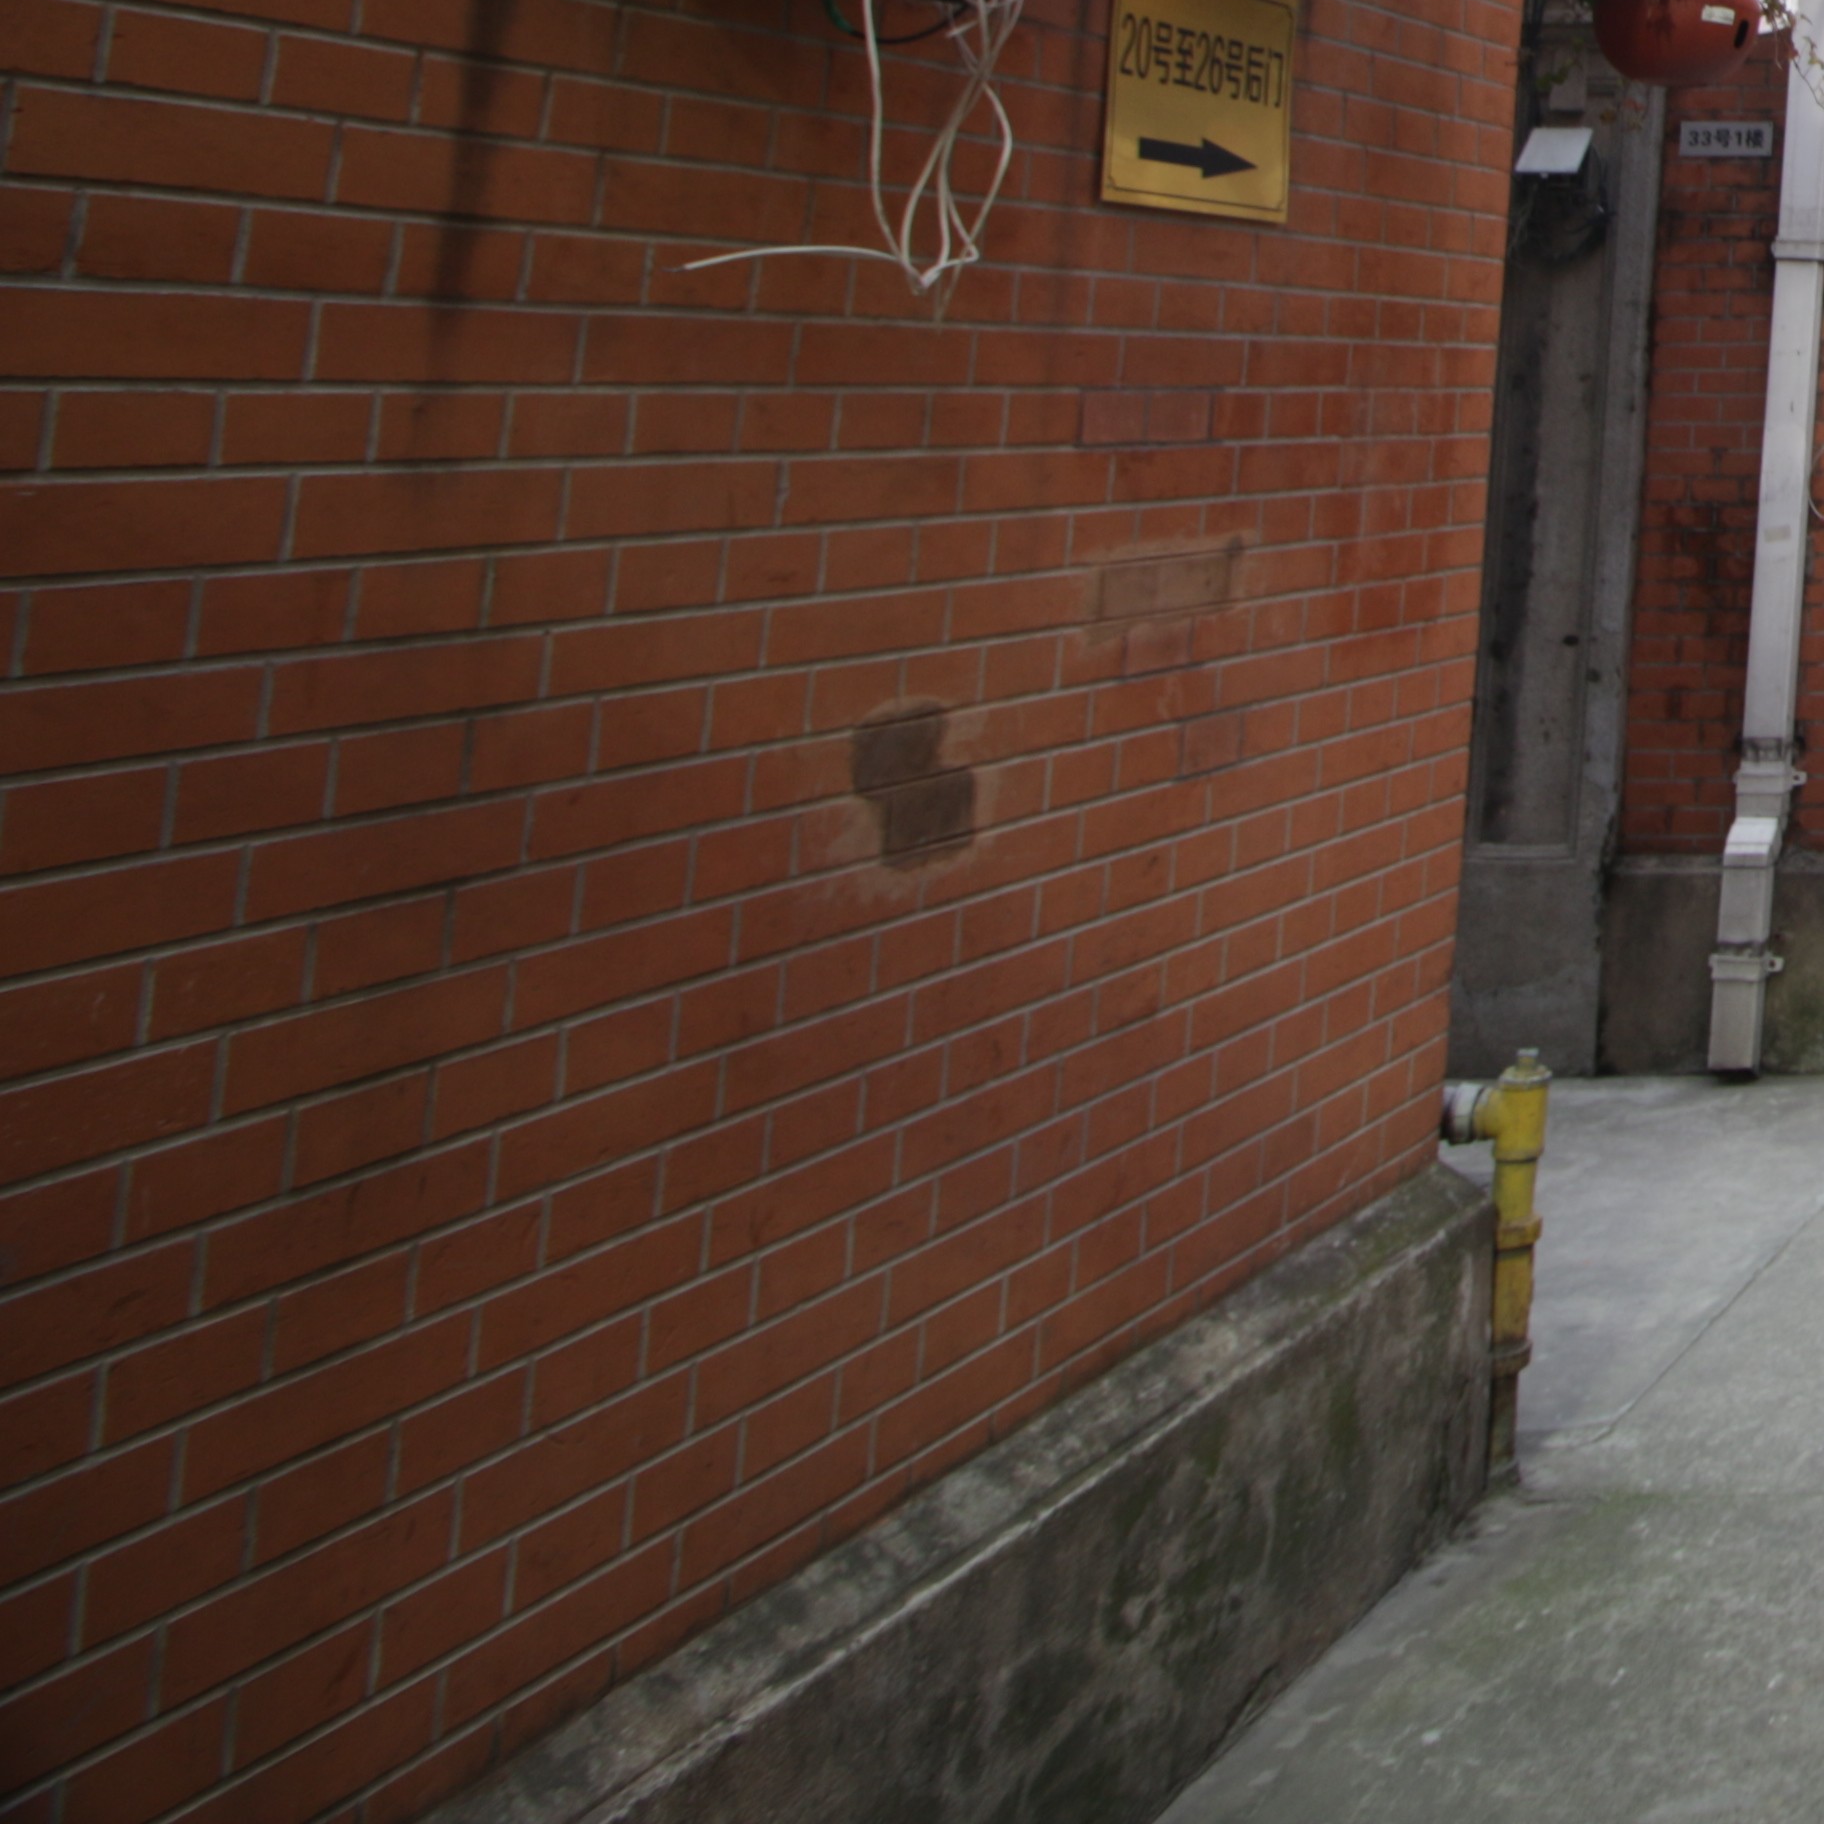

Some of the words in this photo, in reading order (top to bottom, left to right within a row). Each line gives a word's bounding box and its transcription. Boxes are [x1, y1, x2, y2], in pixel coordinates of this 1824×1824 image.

[1119, 13, 1284, 108] 20号至26号后门
[1688, 129, 1764, 149] 33号1楼
